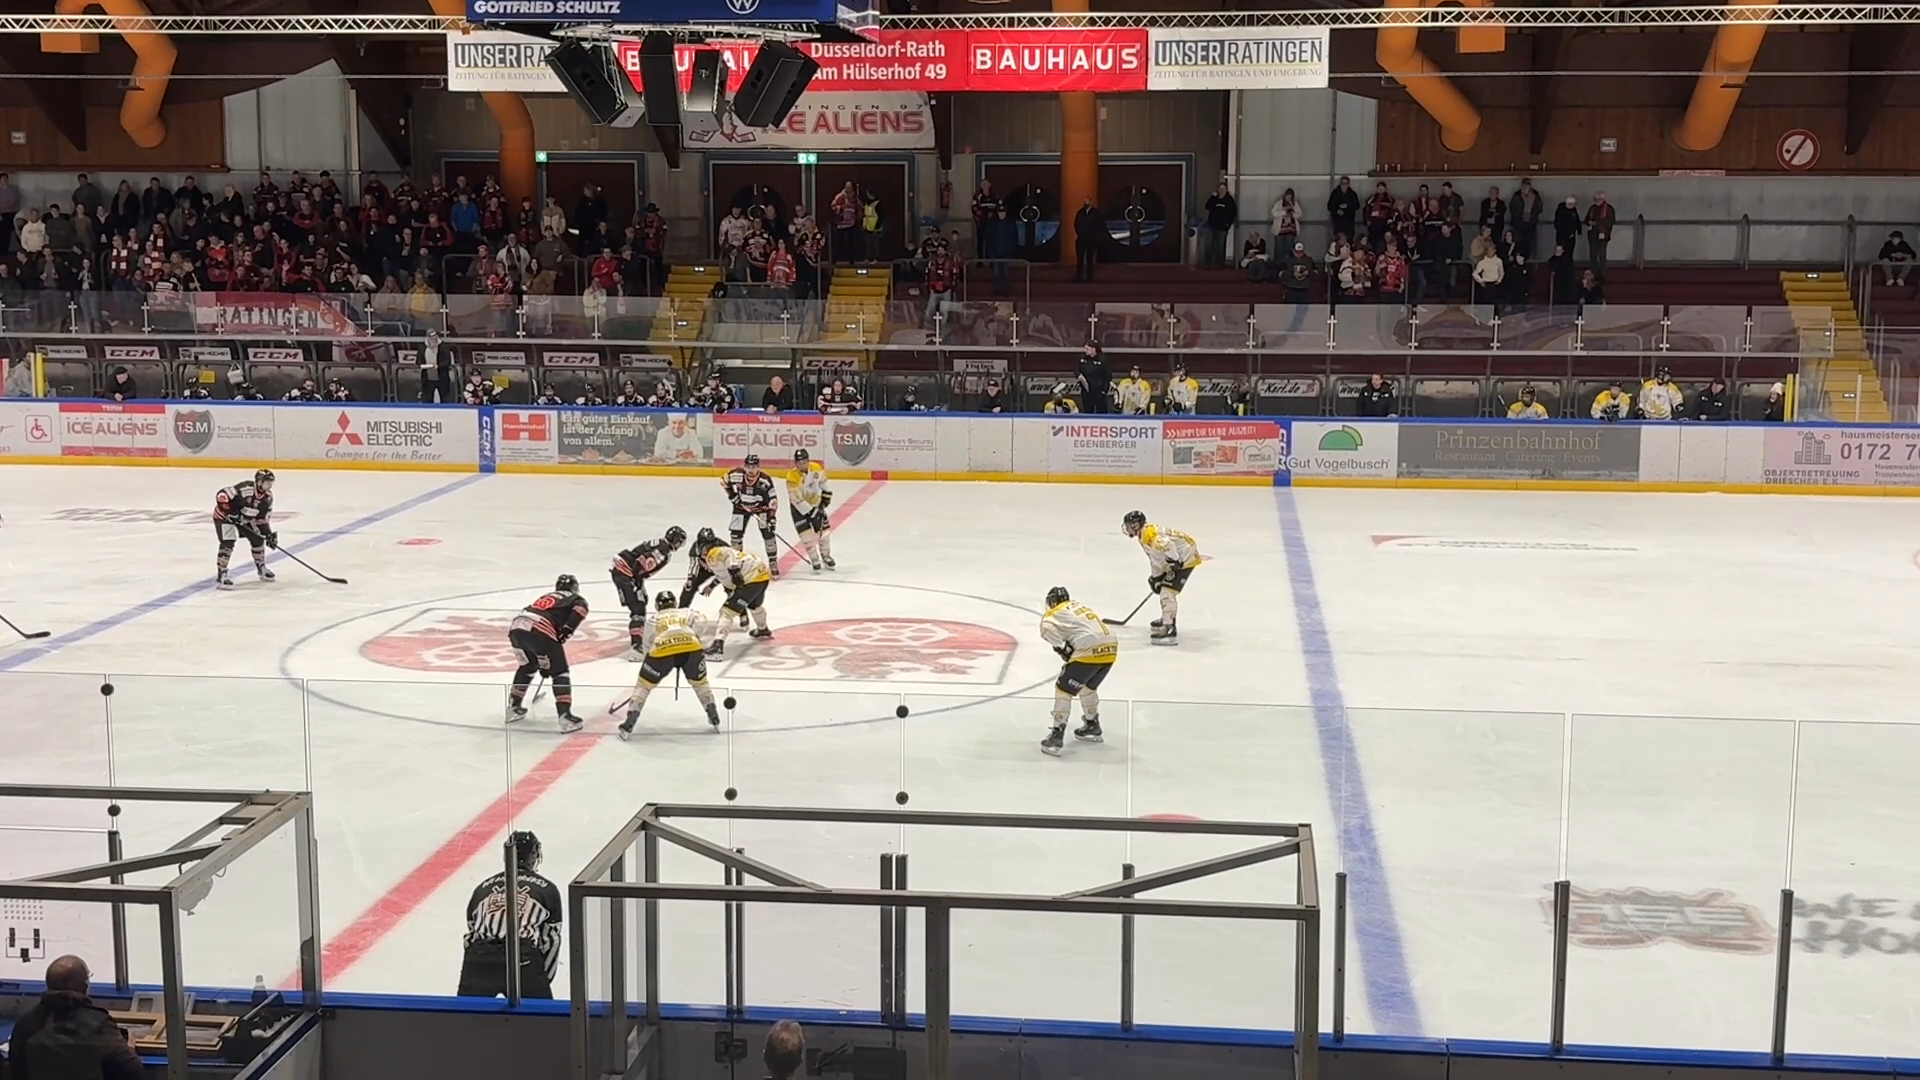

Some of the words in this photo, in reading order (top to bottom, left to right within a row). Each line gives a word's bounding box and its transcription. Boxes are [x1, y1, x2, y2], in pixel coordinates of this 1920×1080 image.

[474, 1, 554, 14] GOTTFRIED
[556, 1, 621, 14] SCHULTZ
[810, 40, 945, 58] Düsseldorf-Rath
[1157, 41, 1222, 66] UNSER
[1227, 40, 1323, 64] RATINGEN
[457, 45, 517, 68] UNSER
[975, 48, 1138, 70] BAUHAUS
[843, 63, 921, 80] Hülserhof
[925, 64, 947, 79] 49
[1154, 70, 1190, 79] ZEITUNG
[1191, 68, 1208, 78] FÜR
[1209, 69, 1251, 78] RATINGEN
[1253, 69, 1272, 77] UND
[1273, 69, 1322, 77] UMGEBUNG
[811, 110, 926, 134] ALIENS
[110, 349, 156, 357] CCM
[548, 356, 596, 364] CCM
[806, 360, 855, 368] CCM
[562, 413, 580, 424] Ein
[582, 414, 609, 426] guter
[67, 421, 92, 434] ICE
[96, 422, 158, 436] ALIENS
[177, 421, 208, 433] T.S.M
[367, 421, 443, 434] MITSUBISHI
[562, 425, 577, 434] ist
[578, 425, 594, 435] der
[596, 425, 633, 437] Anfang
[1065, 425, 1157, 439] INTERSPORT
[367, 434, 432, 447] ELECTRIC
[563, 437, 582, 446] von
[584, 436, 615, 446] allem.
[721, 433, 747, 446] ICE
[750, 434, 818, 447] ALIENS
[835, 433, 868, 446] T.S.M
[1074, 440, 1137, 449] EGENBERGER
[1436, 430, 1602, 450] Prinzenbahnhof
[325, 449, 369, 461] Changes
[372, 450, 388, 460] for
[391, 450, 407, 460] the
[1435, 451, 1496, 462] Restaurant
[1505, 452, 1555, 464] Catering
[1563, 452, 1601, 463] Events
[1840, 443, 1891, 460] 0172
[1905, 444, 1920, 460] 7
[1288, 457, 1311, 469] Gut
[1315, 457, 1389, 471] Vogelbusch
[1764, 469, 1860, 478] OBJEKTBETREUUNG
[1765, 477, 1819, 485] DRIESCHER
